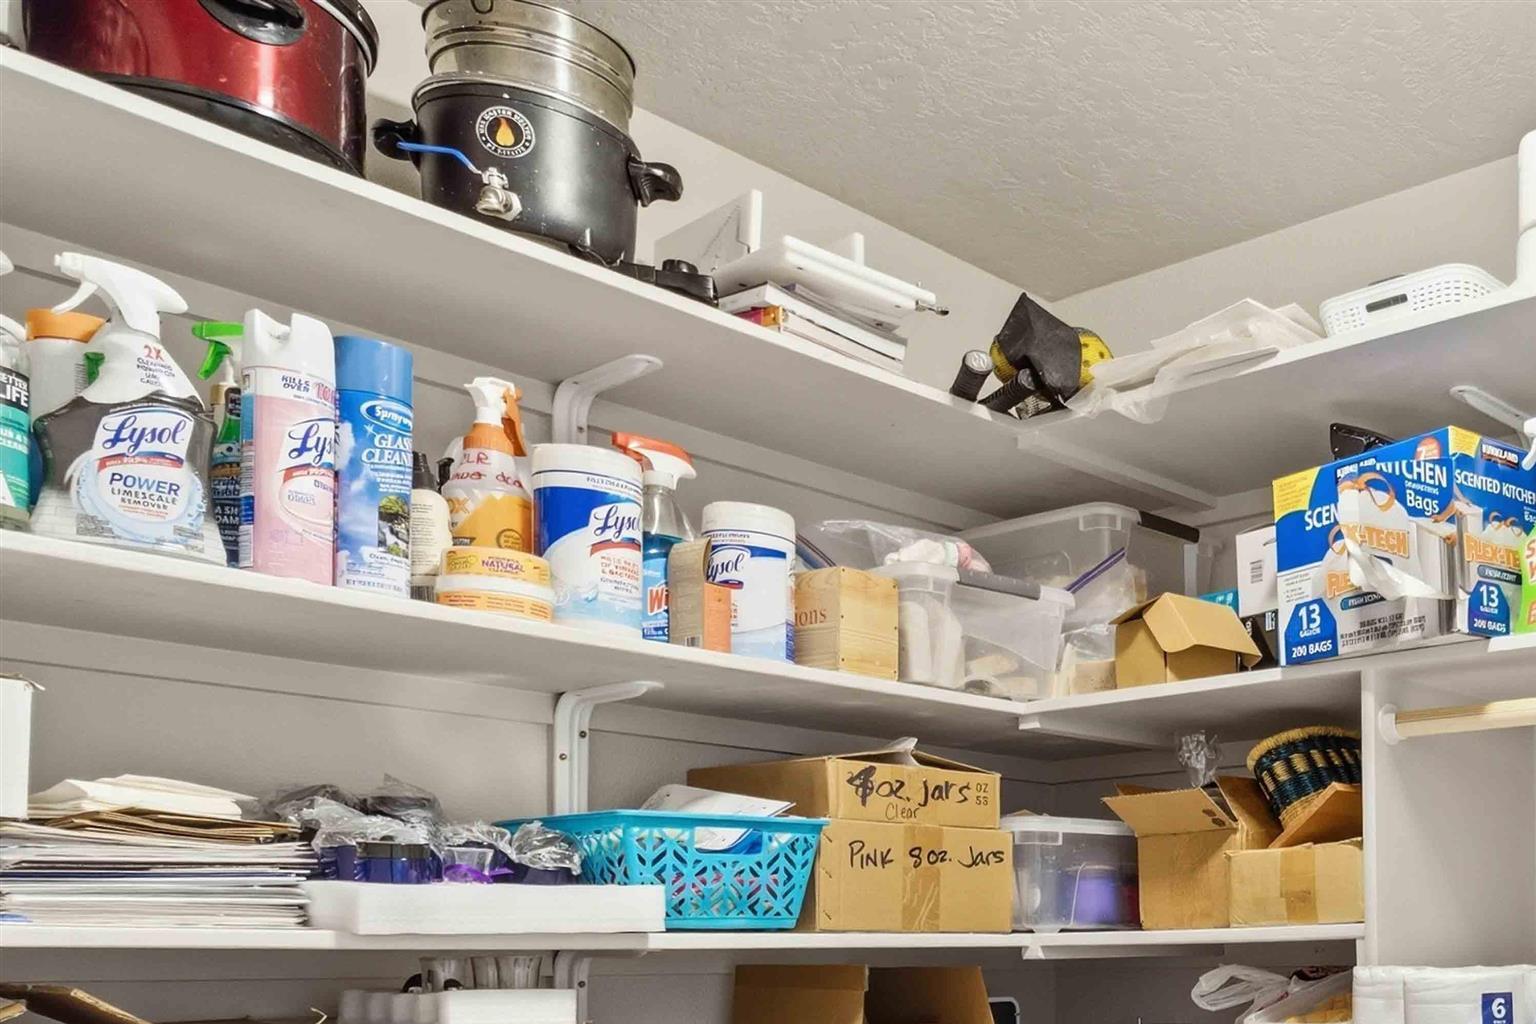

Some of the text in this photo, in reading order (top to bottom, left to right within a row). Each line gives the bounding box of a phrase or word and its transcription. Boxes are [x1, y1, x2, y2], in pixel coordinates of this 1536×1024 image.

[0, 374, 28, 390] ETTER
[103, 415, 186, 457] Lysol
[288, 423, 335, 464] Lys
[361, 449, 412, 464] CLEAN
[109, 472, 180, 497] POWER
[1455, 469, 1501, 494] SCENTED
[111, 488, 178, 505] LIMESCALE
[121, 498, 169, 510] REMOVER
[1406, 489, 1439, 516] Bags
[593, 505, 643, 541] Lyso
[1304, 503, 1338, 531] SCEN
[1465, 536, 1520, 568] FLEX-TE
[1479, 585, 1499, 607] 13
[795, 606, 827, 626] ions
[1298, 604, 1321, 629] 13
[1291, 640, 1332, 659] 200 BAGS
[885, 804, 920, 822] Clear
[849, 840, 894, 870] PINK
[1491, 997, 1506, 1019] 6
